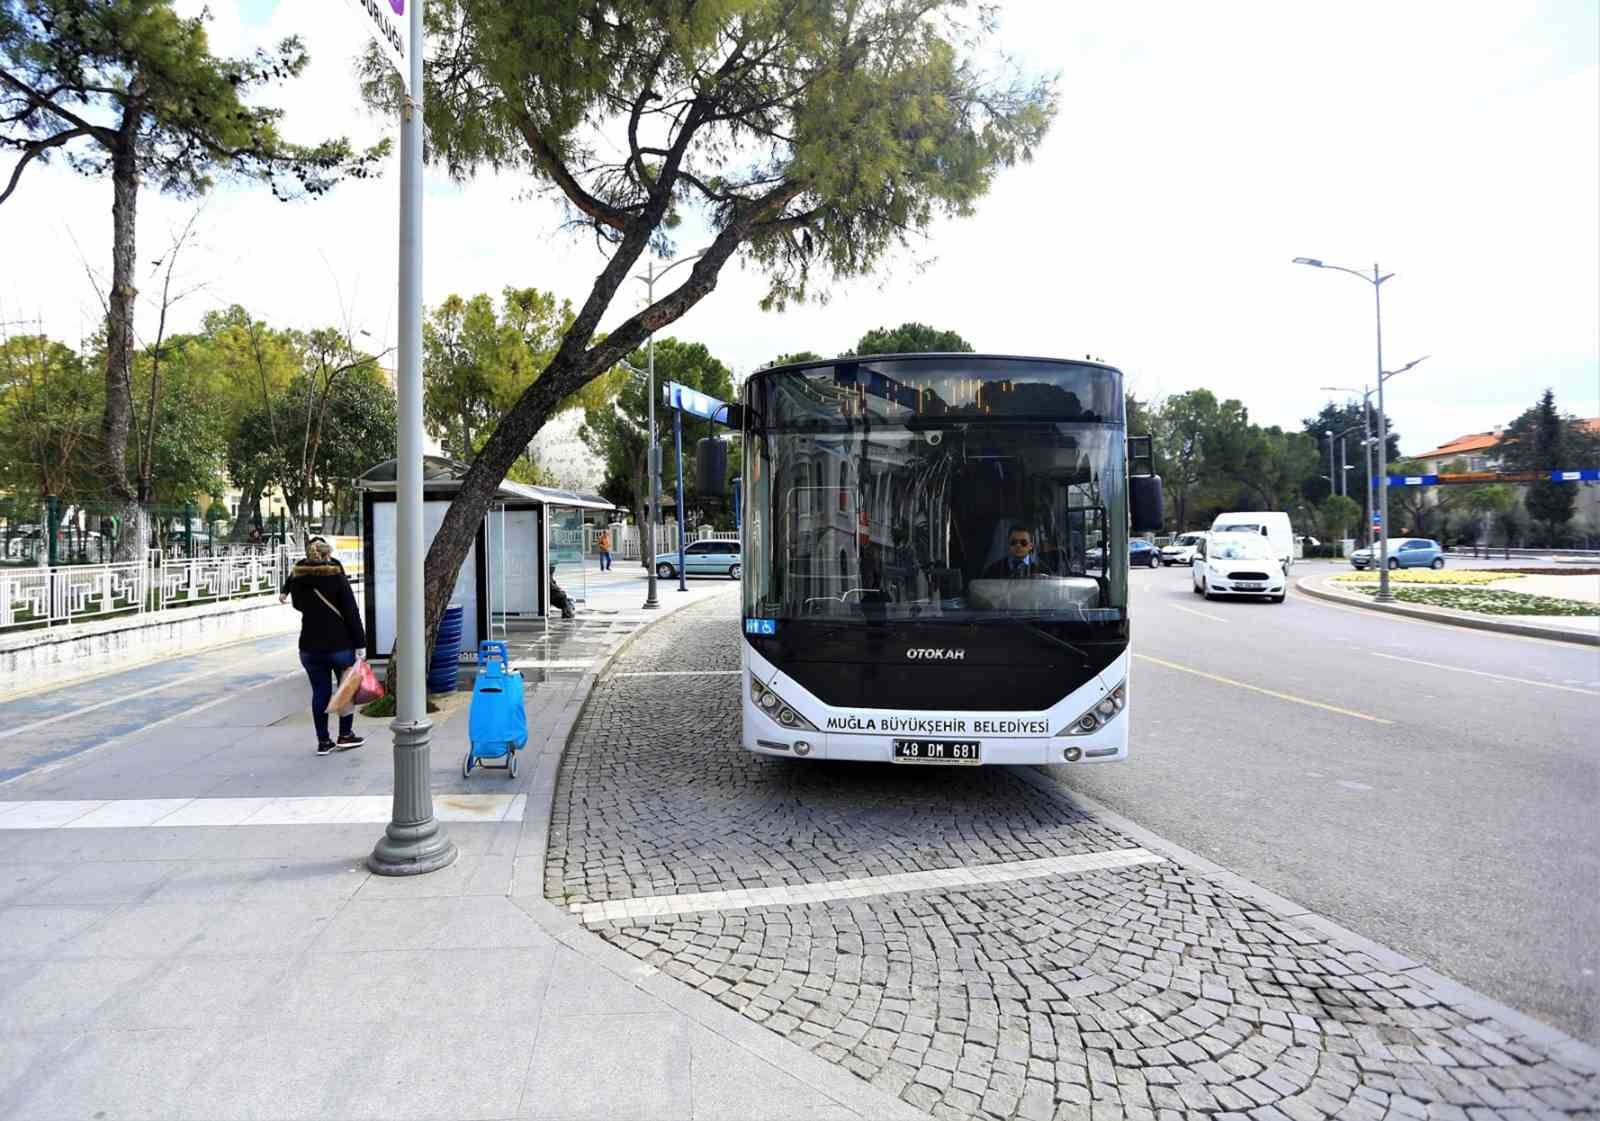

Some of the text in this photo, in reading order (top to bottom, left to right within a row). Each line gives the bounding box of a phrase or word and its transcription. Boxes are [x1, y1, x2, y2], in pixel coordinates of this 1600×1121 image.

[906, 648, 965, 660] OTOKAR
[826, 715, 1049, 735] MUĞLA BÜYÜKŞEHİR BELEDİYESİ
[902, 742, 976, 758] 48 DM 681
